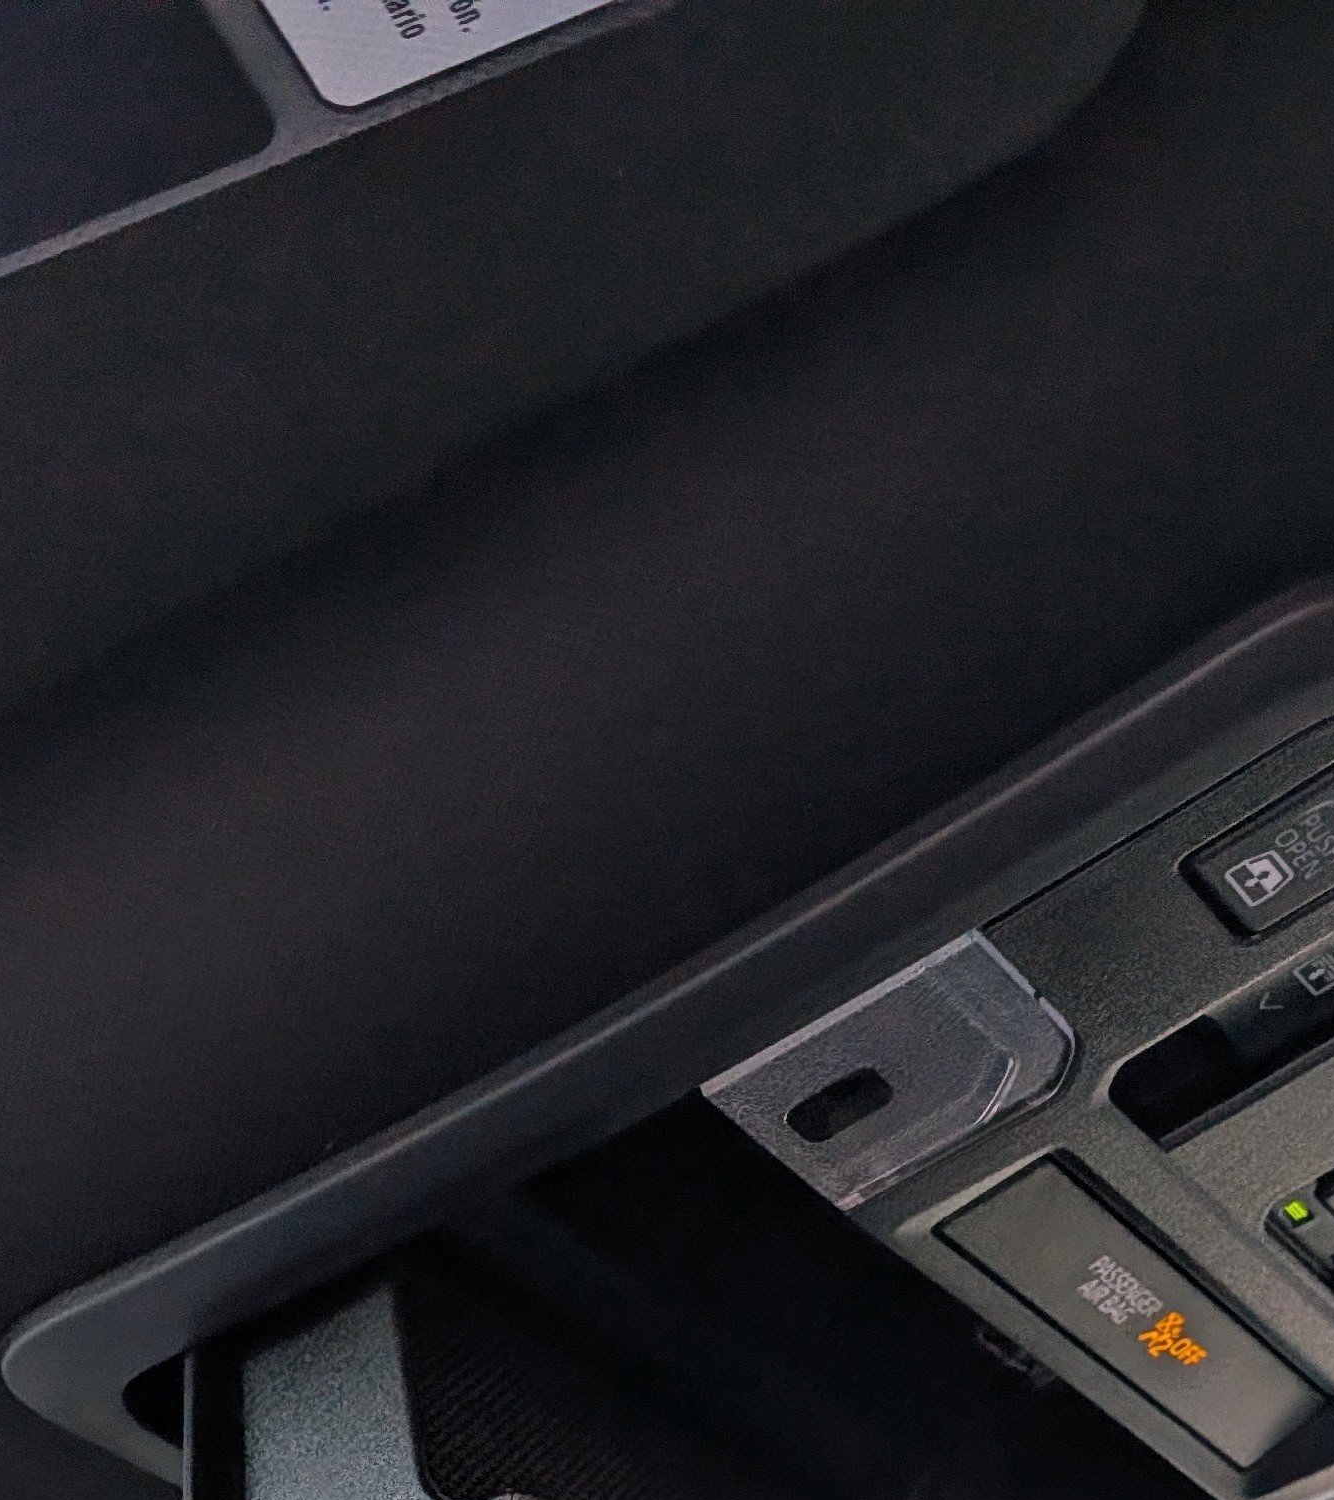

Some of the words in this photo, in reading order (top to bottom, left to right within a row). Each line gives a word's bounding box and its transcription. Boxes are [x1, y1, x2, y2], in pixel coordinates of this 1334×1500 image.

[1273, 827, 1320, 880] OPEN
[1076, 1278, 1111, 1305] AIR
[1098, 1294, 1136, 1325] BAG
[1088, 1254, 1164, 1317] PASSENGER
[1168, 1337, 1209, 1366] OFF
